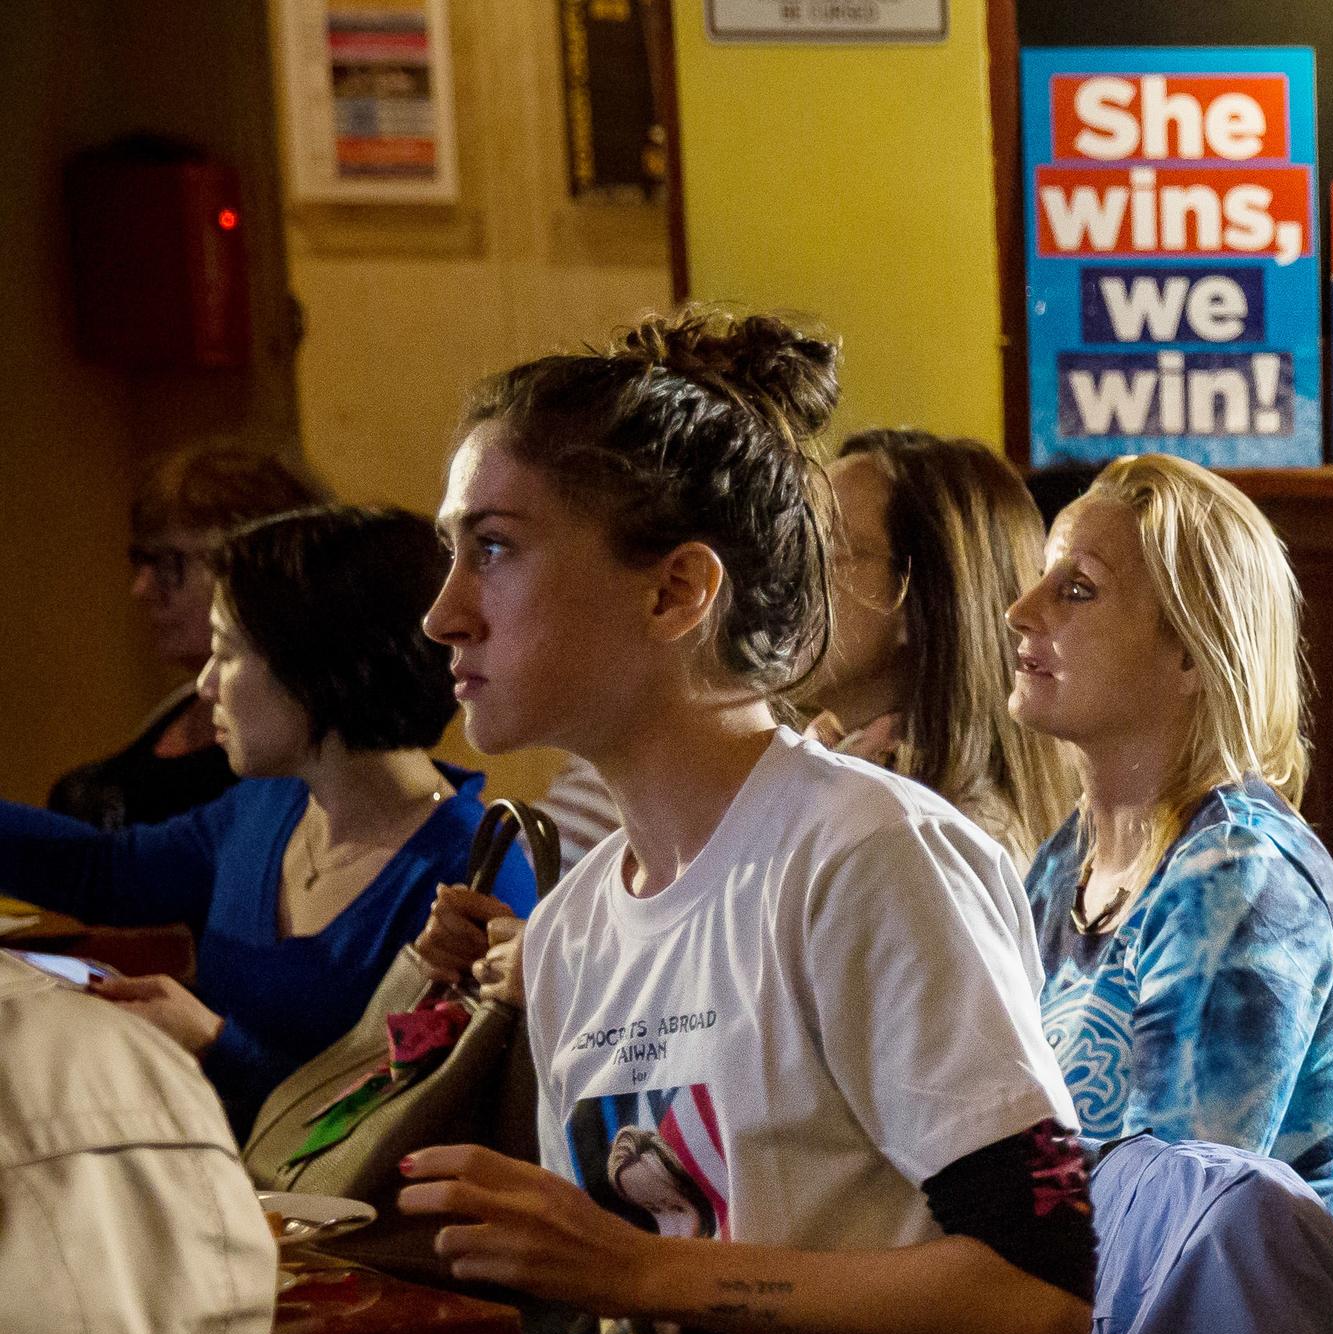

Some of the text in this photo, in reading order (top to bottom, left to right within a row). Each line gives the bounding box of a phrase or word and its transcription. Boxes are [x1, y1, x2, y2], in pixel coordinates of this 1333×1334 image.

[1074, 75, 1267, 161] She
[1041, 166, 1303, 266] wins,
[1101, 275, 1249, 343] we
[1069, 350, 1281, 435] win!
[657, 1010, 718, 1037] ABROAD
